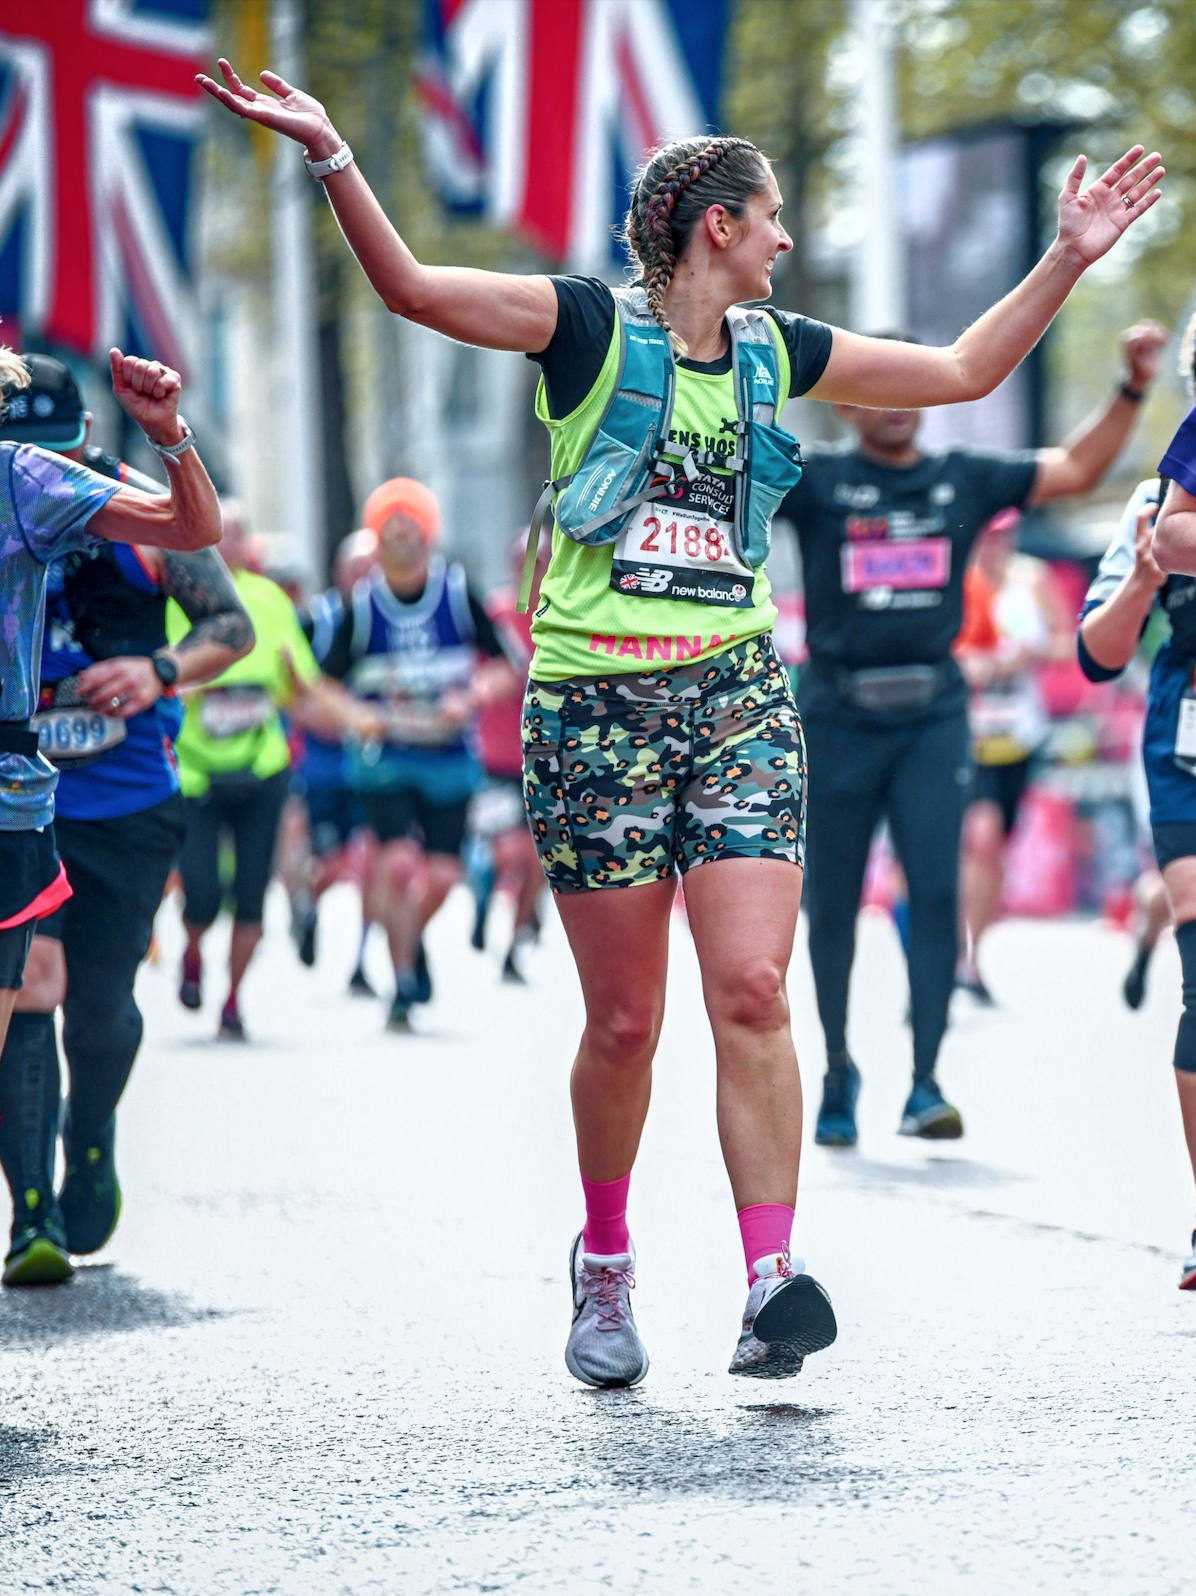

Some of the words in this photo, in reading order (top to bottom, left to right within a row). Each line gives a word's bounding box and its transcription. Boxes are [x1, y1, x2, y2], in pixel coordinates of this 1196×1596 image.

[588, 468, 616, 512] AONIJIE
[697, 473, 726, 491] TATA
[671, 585, 696, 597] new
